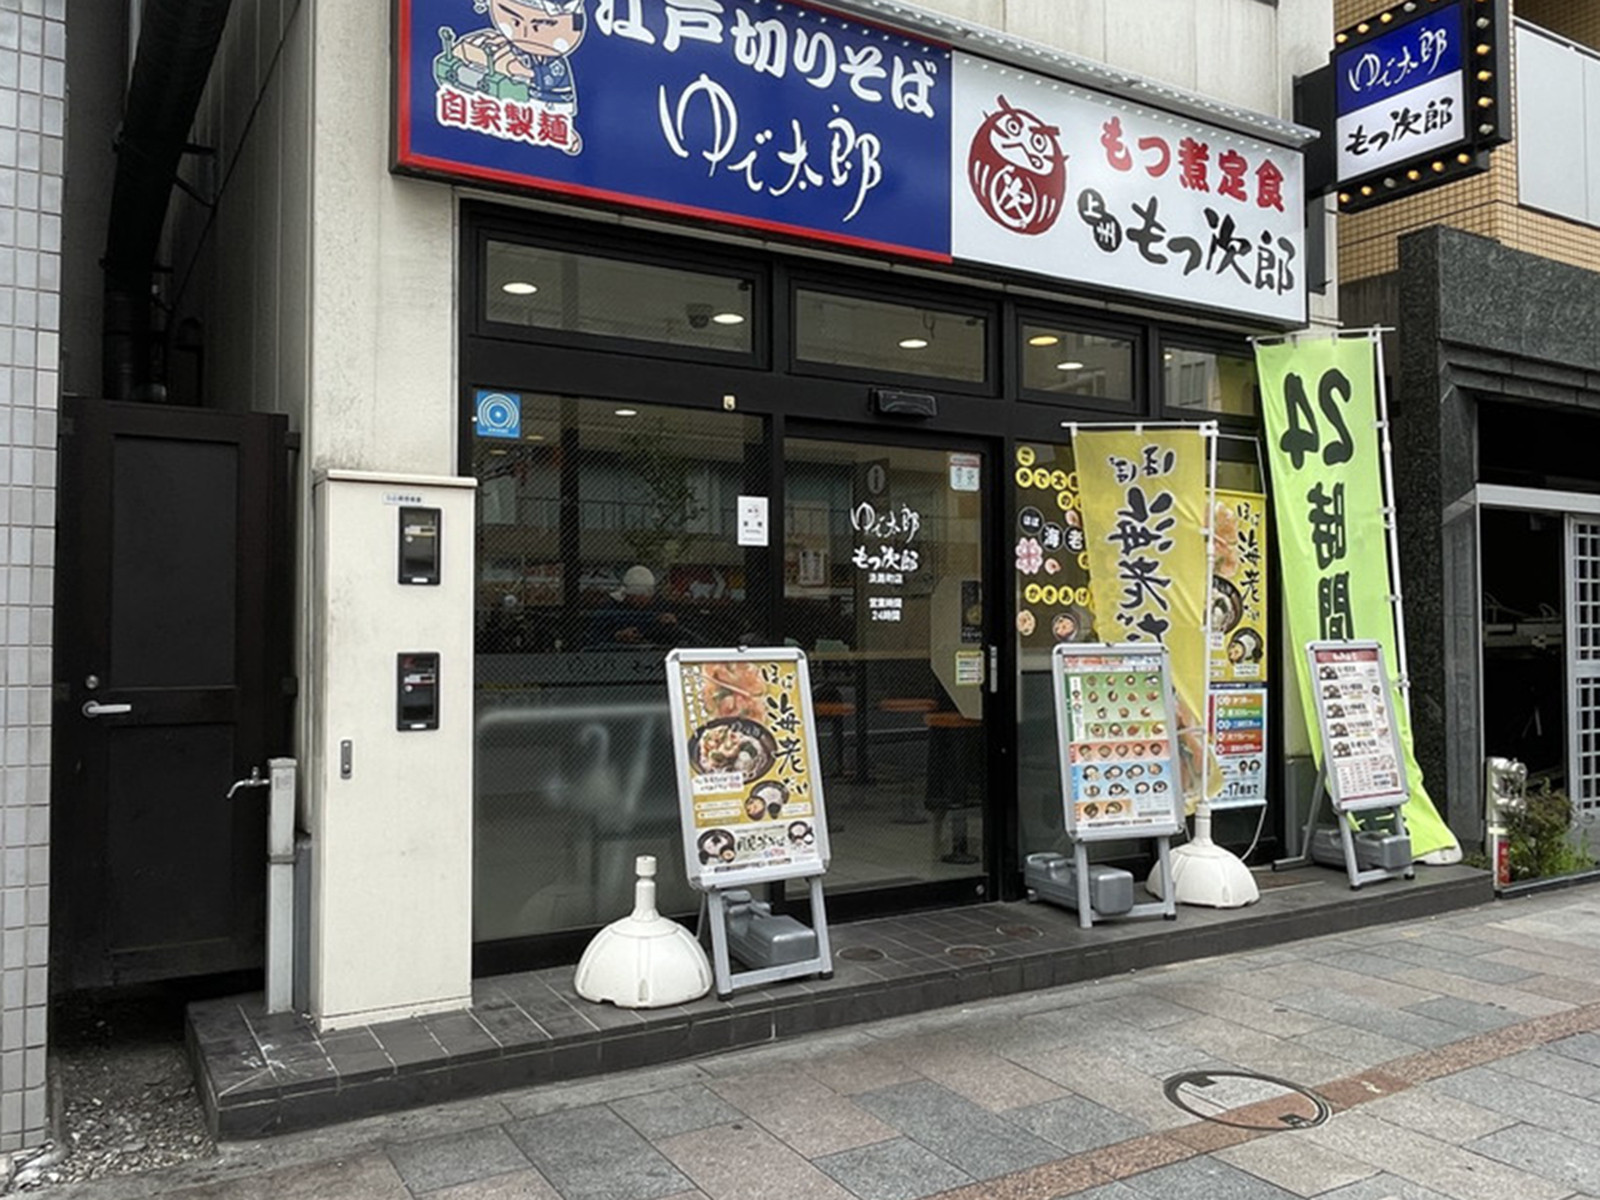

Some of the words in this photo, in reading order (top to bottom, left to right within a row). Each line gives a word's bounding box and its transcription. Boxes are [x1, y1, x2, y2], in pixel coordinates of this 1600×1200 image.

[594, 0, 937, 119] 江戸切りそば
[436, 89, 572, 149] 自家製麺
[658, 72, 882, 222] ゆで太郎
[1100, 115, 1286, 213] もつ煮定食
[1345, 96, 1454, 157] もつ次郎
[1127, 196, 1295, 296] もつ次郎
[852, 545, 920, 572] もつ次郎
